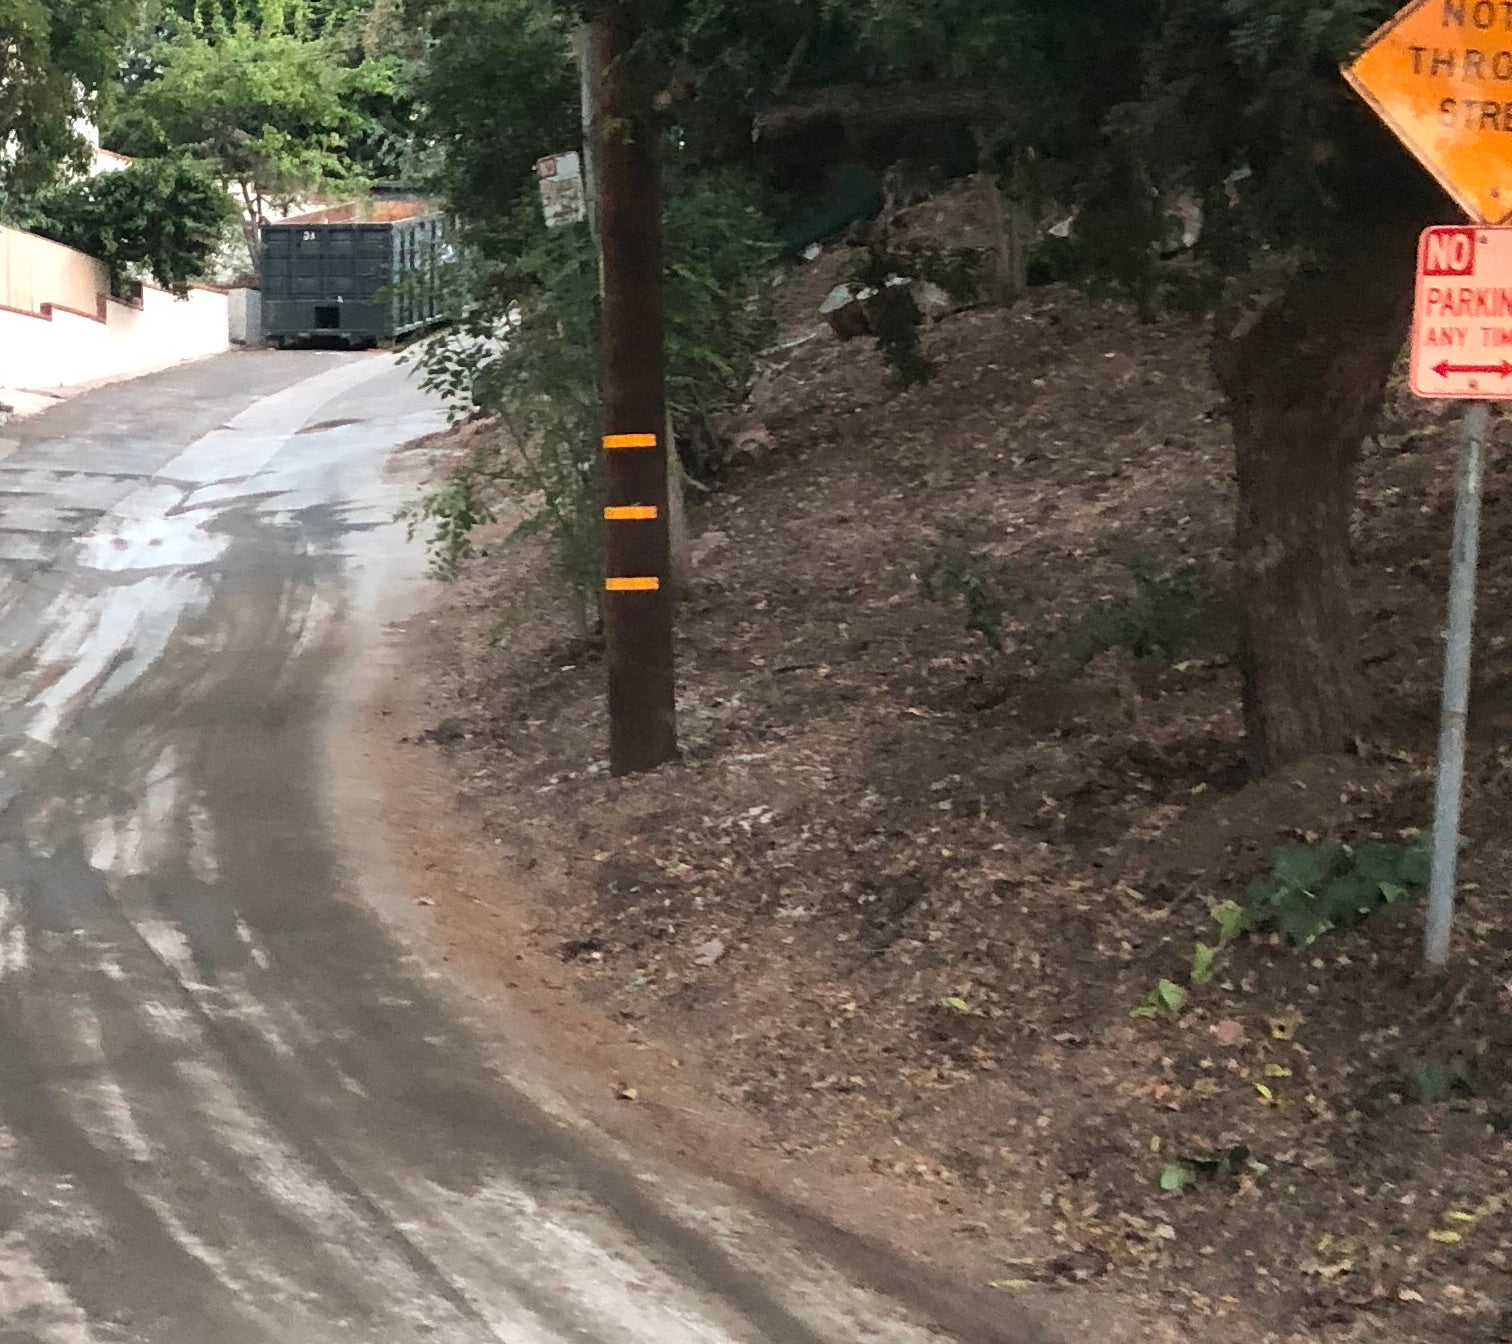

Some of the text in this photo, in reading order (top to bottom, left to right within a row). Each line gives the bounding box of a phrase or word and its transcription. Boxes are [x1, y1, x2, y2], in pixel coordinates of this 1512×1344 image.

[1408, 45, 1512, 81] THRO
[1427, 233, 1471, 272] NO
[1424, 327, 1467, 346] ANY
